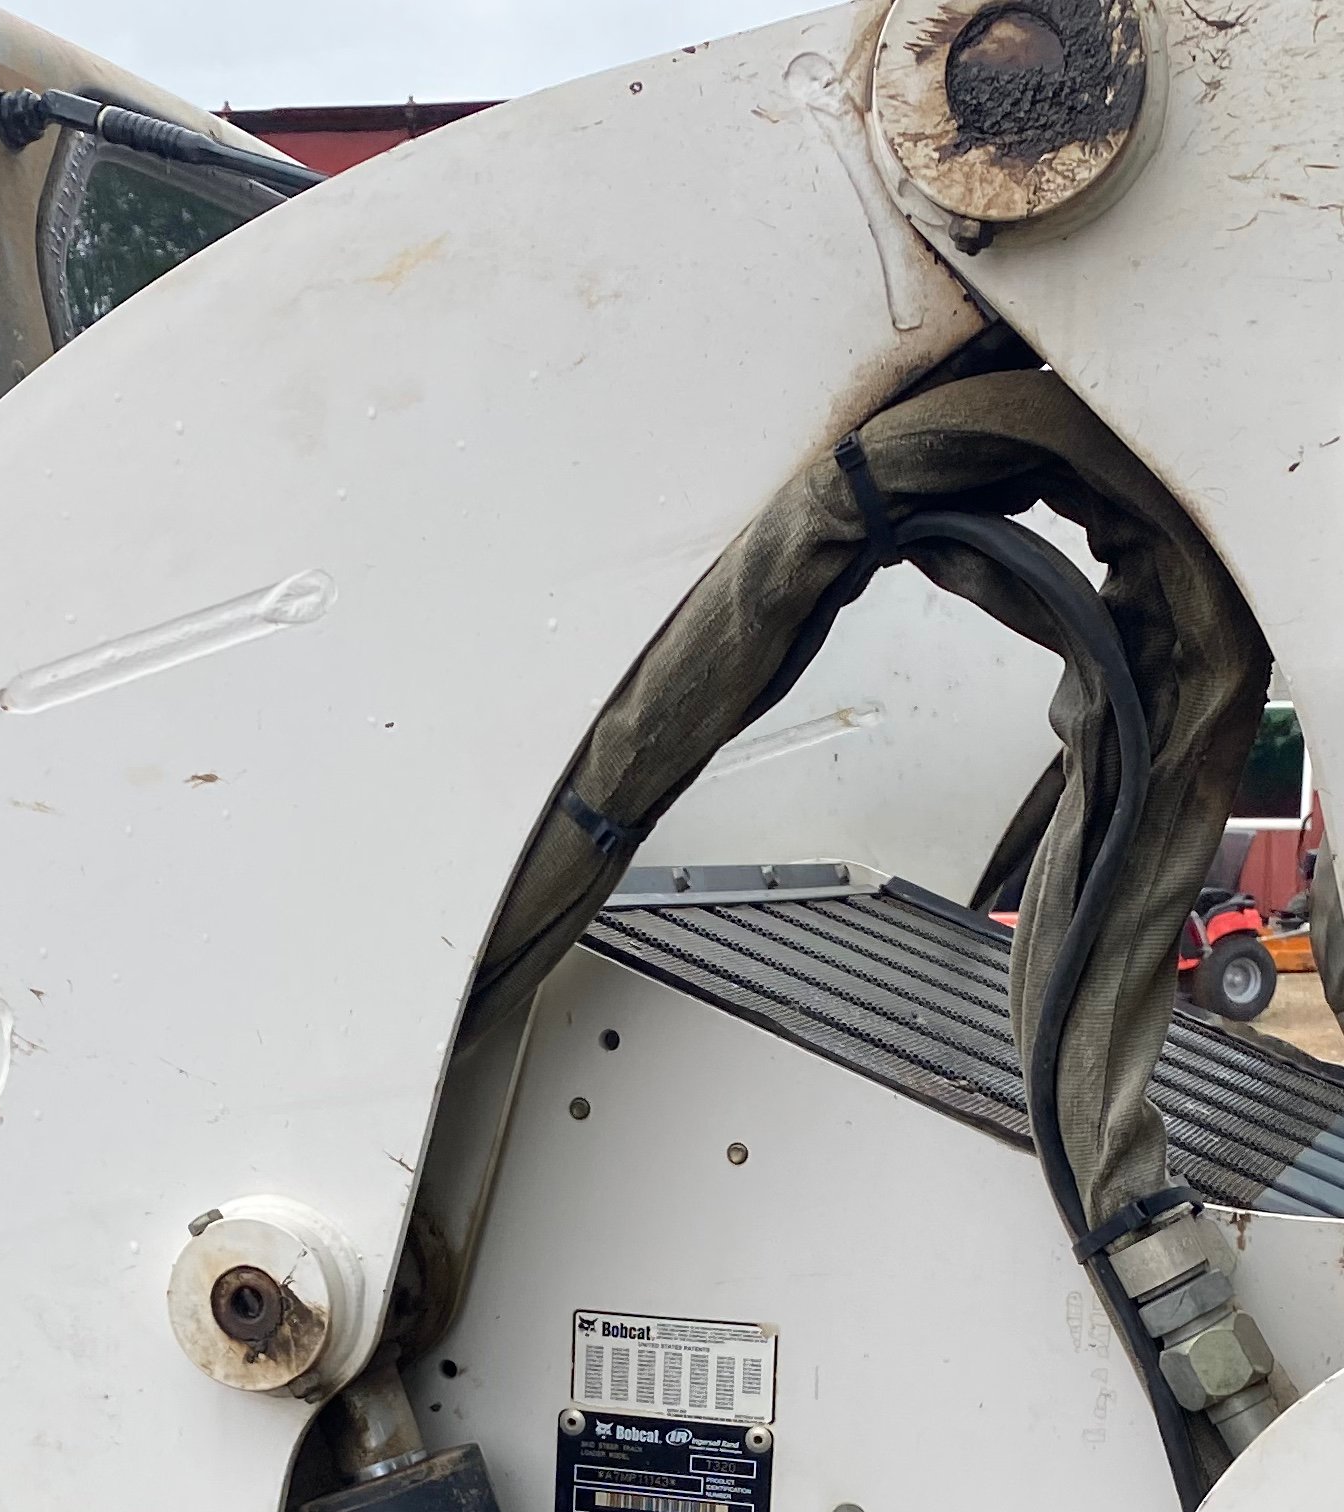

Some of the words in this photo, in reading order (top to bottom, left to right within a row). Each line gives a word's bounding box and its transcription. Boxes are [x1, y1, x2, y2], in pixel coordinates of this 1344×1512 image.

[602, 1322, 651, 1341] Bobcat
[616, 1425, 660, 1443] Bobcat
[706, 1459, 736, 1473] T320
